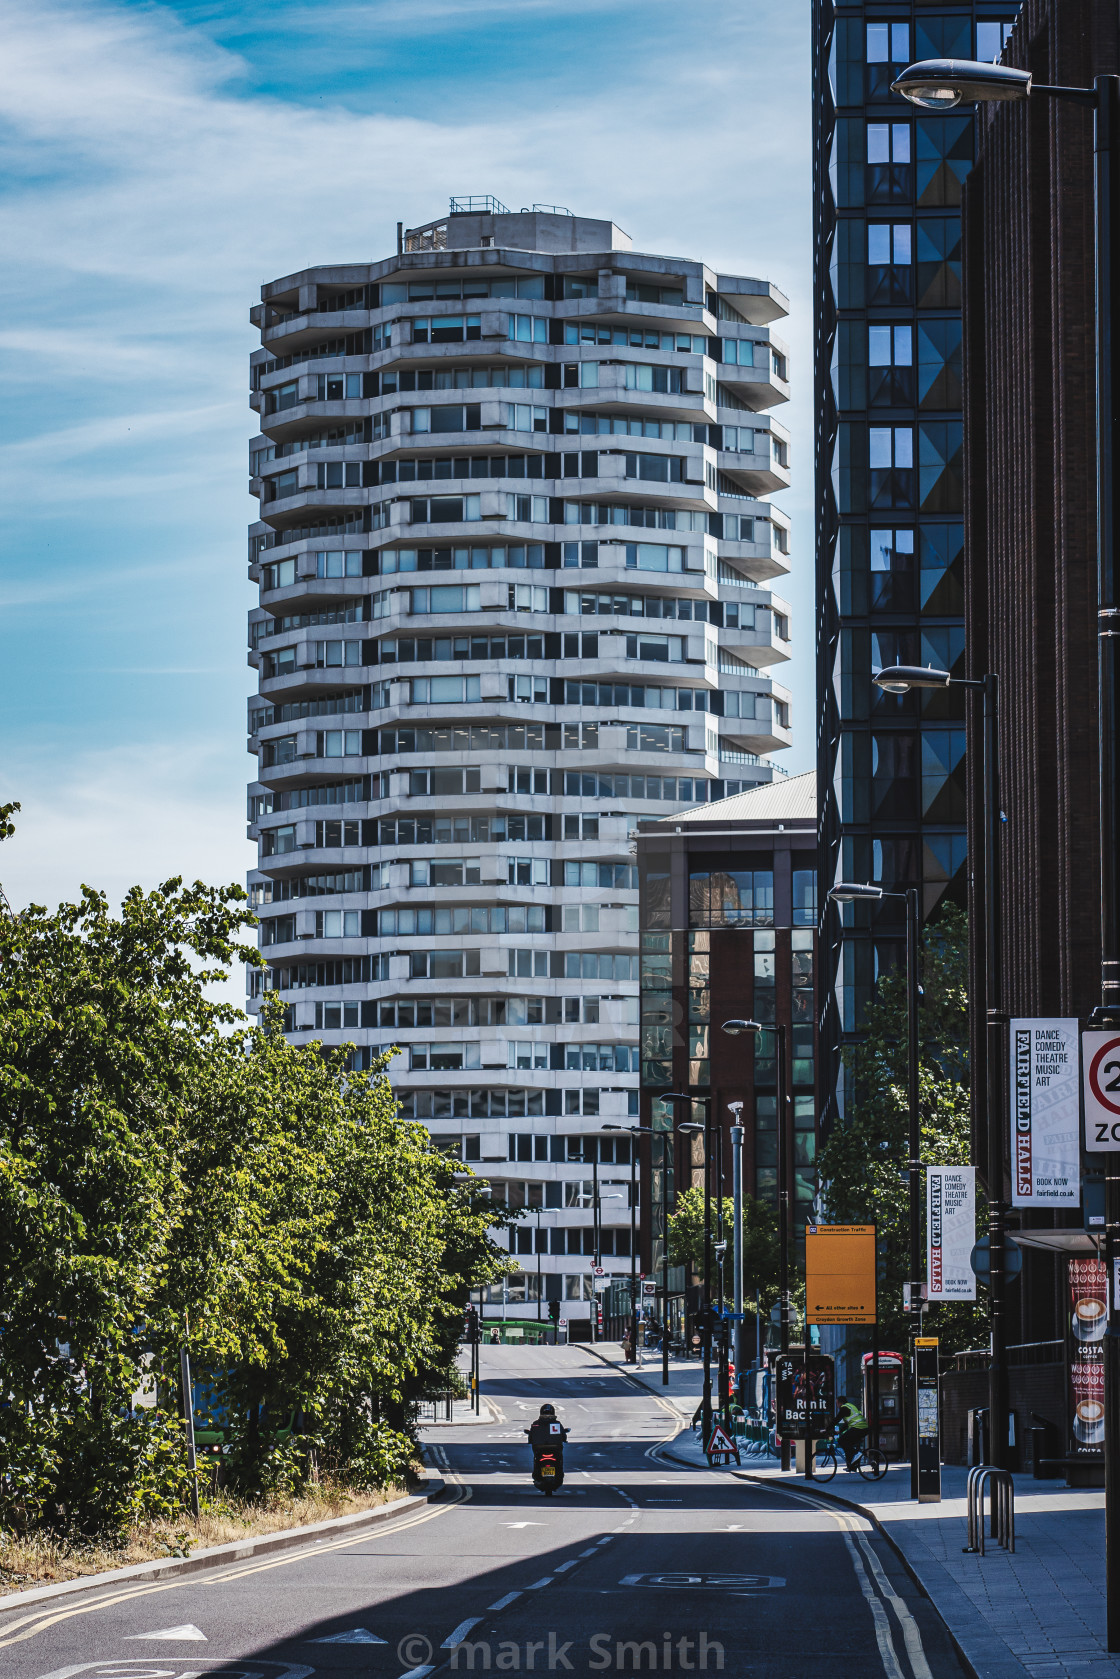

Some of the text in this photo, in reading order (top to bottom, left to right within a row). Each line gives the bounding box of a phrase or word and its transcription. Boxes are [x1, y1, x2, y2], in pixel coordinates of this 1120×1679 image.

[1035, 1030, 1060, 1039] DANCE
[1035, 1042, 1066, 1051] COMEDY
[1035, 1053, 1068, 1063] THEATRE
[1035, 1065, 1060, 1075] MUSIC
[1035, 1077, 1051, 1086] ART
[1017, 1032, 1031, 1194] FAIRFIELD HALLS
[944, 1174, 962, 1182] DANCE
[1036, 1178, 1069, 1186] BOOK NOW
[944, 1191, 968, 1199] THEATRE
[1036, 1189, 1075, 1197] fairfield.co.uk
[932, 1176, 941, 1291] FAIRFIELD HALLS
[1078, 1346, 1104, 1355] COSTA
[819, 1398, 827, 1410] it
